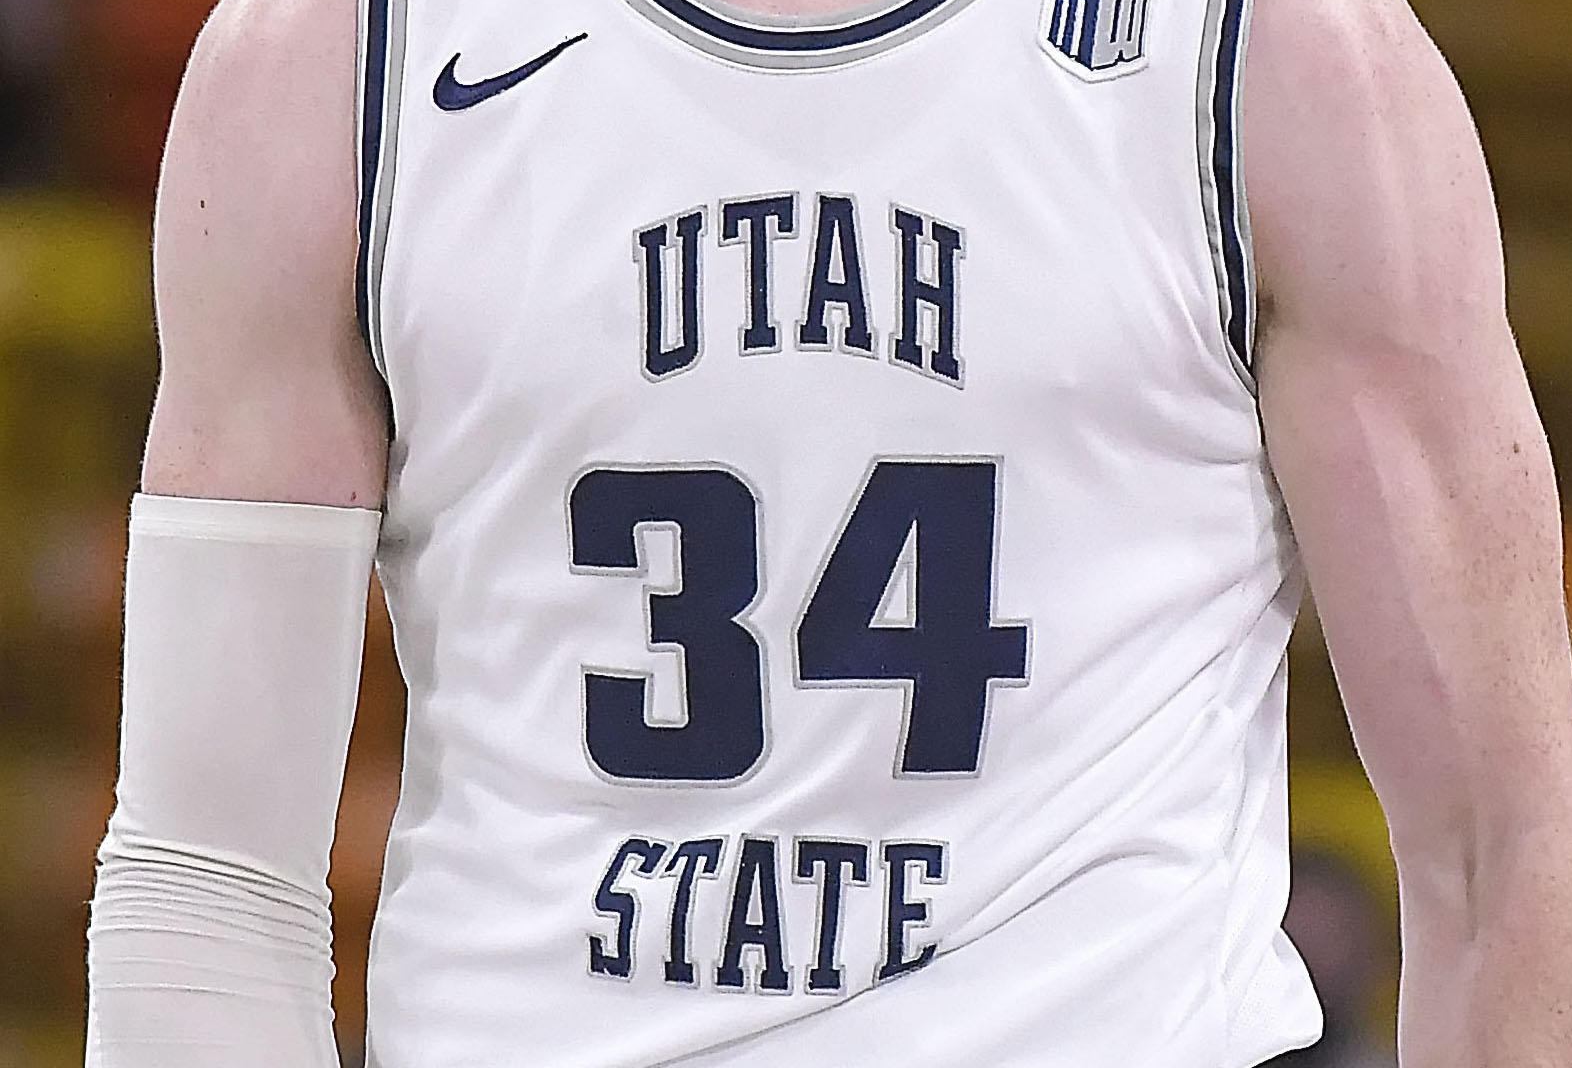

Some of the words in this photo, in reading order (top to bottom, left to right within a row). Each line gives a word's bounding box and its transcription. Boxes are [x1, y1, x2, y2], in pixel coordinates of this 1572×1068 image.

[633, 191, 967, 389] UTAH
[564, 454, 1033, 787] 34
[587, 833, 950, 995] STATE
